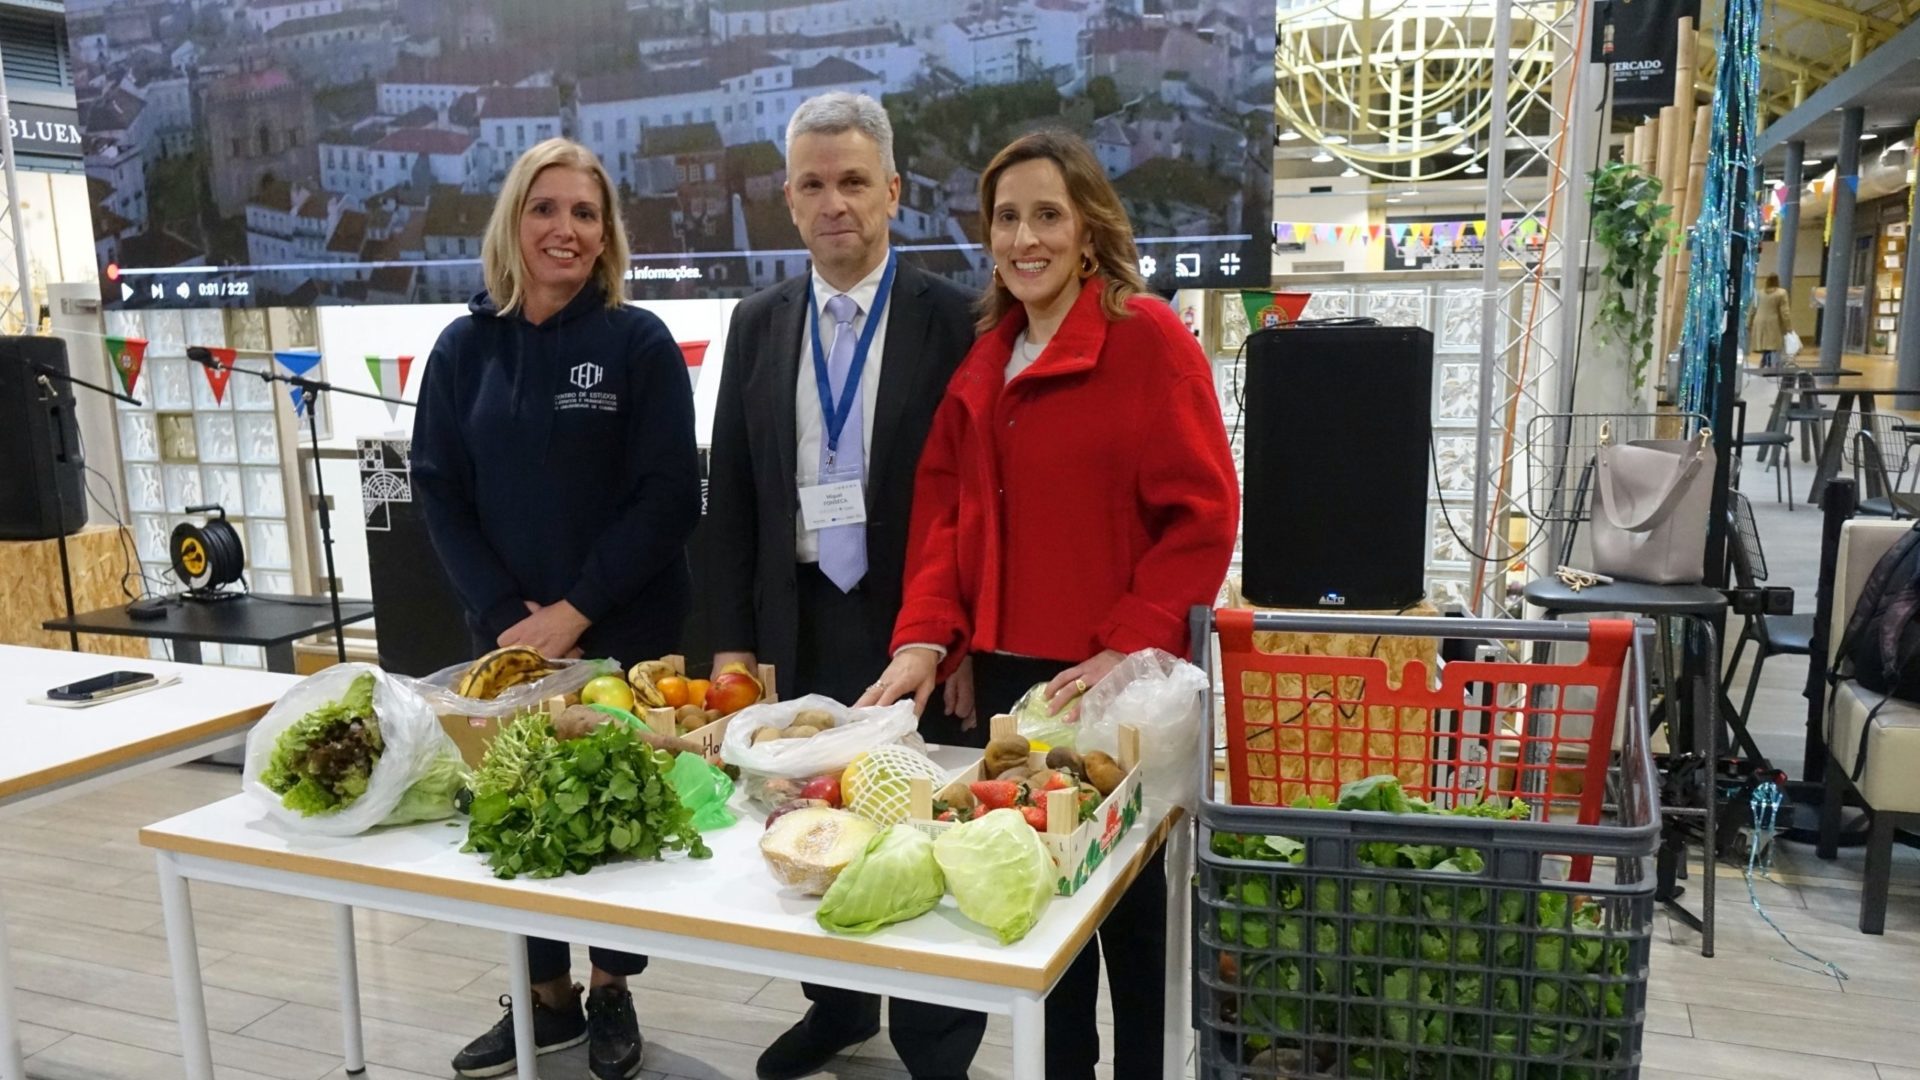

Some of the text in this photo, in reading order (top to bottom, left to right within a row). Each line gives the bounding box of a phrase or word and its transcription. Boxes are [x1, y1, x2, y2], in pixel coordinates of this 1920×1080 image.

[634, 265, 703, 282] informações.
[198, 282, 219, 296] 0:01
[227, 281, 249, 296] 3:22
[569, 361, 604, 390] CECH
[1318, 595, 1345, 605] ALTO
